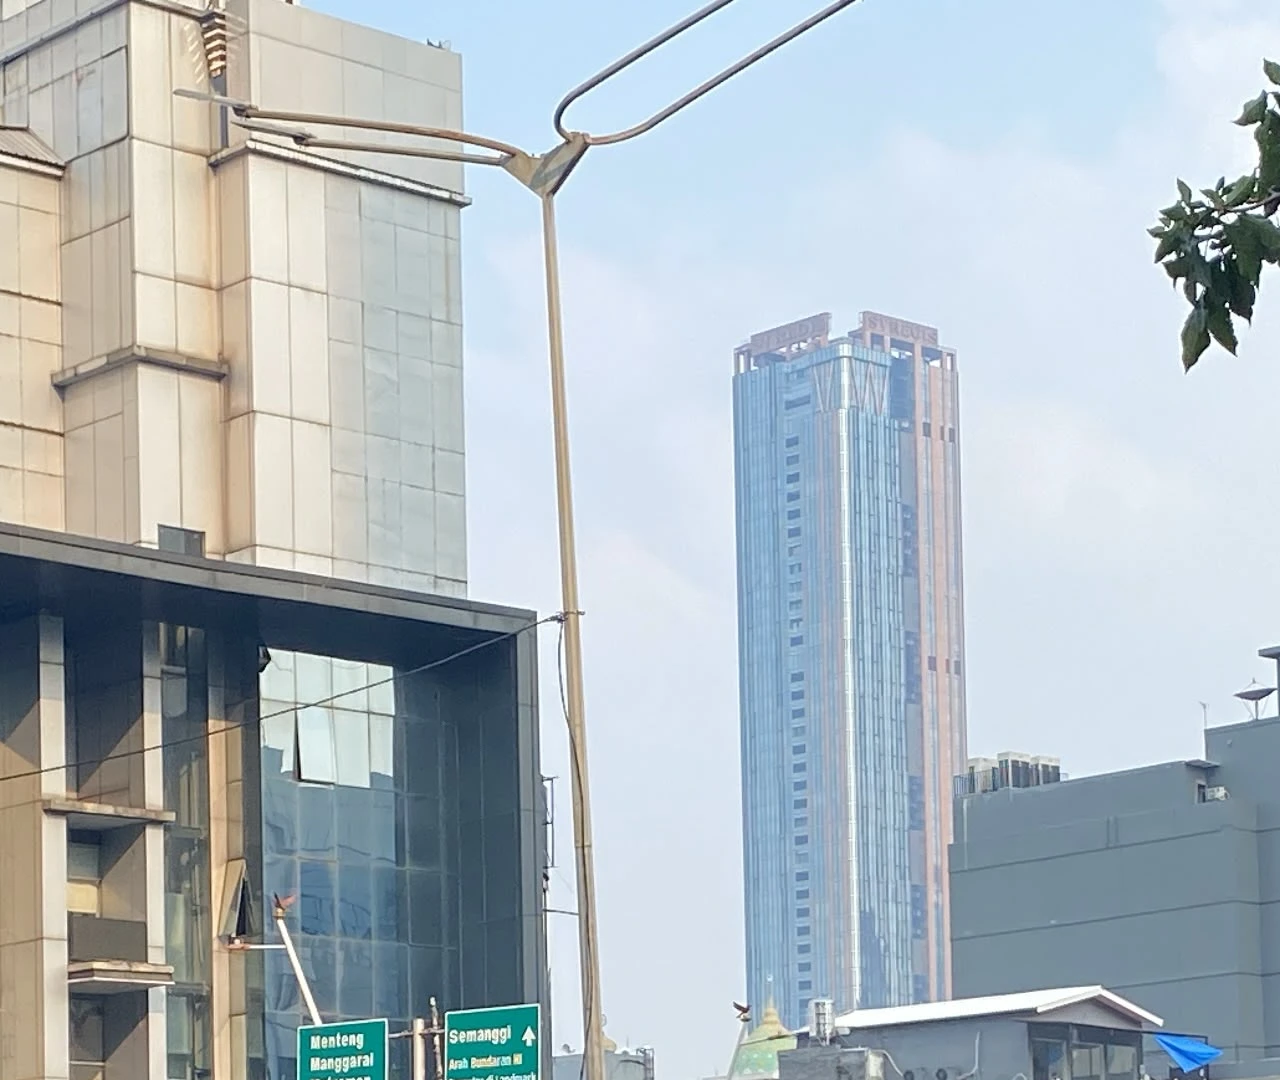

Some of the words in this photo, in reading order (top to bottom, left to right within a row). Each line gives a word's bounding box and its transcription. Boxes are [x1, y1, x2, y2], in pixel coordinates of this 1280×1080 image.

[310, 1032, 364, 1050] Menteng
[449, 1025, 512, 1045] Semanggi
[310, 1052, 374, 1074] Manggarai
[449, 1057, 469, 1071] Arah
